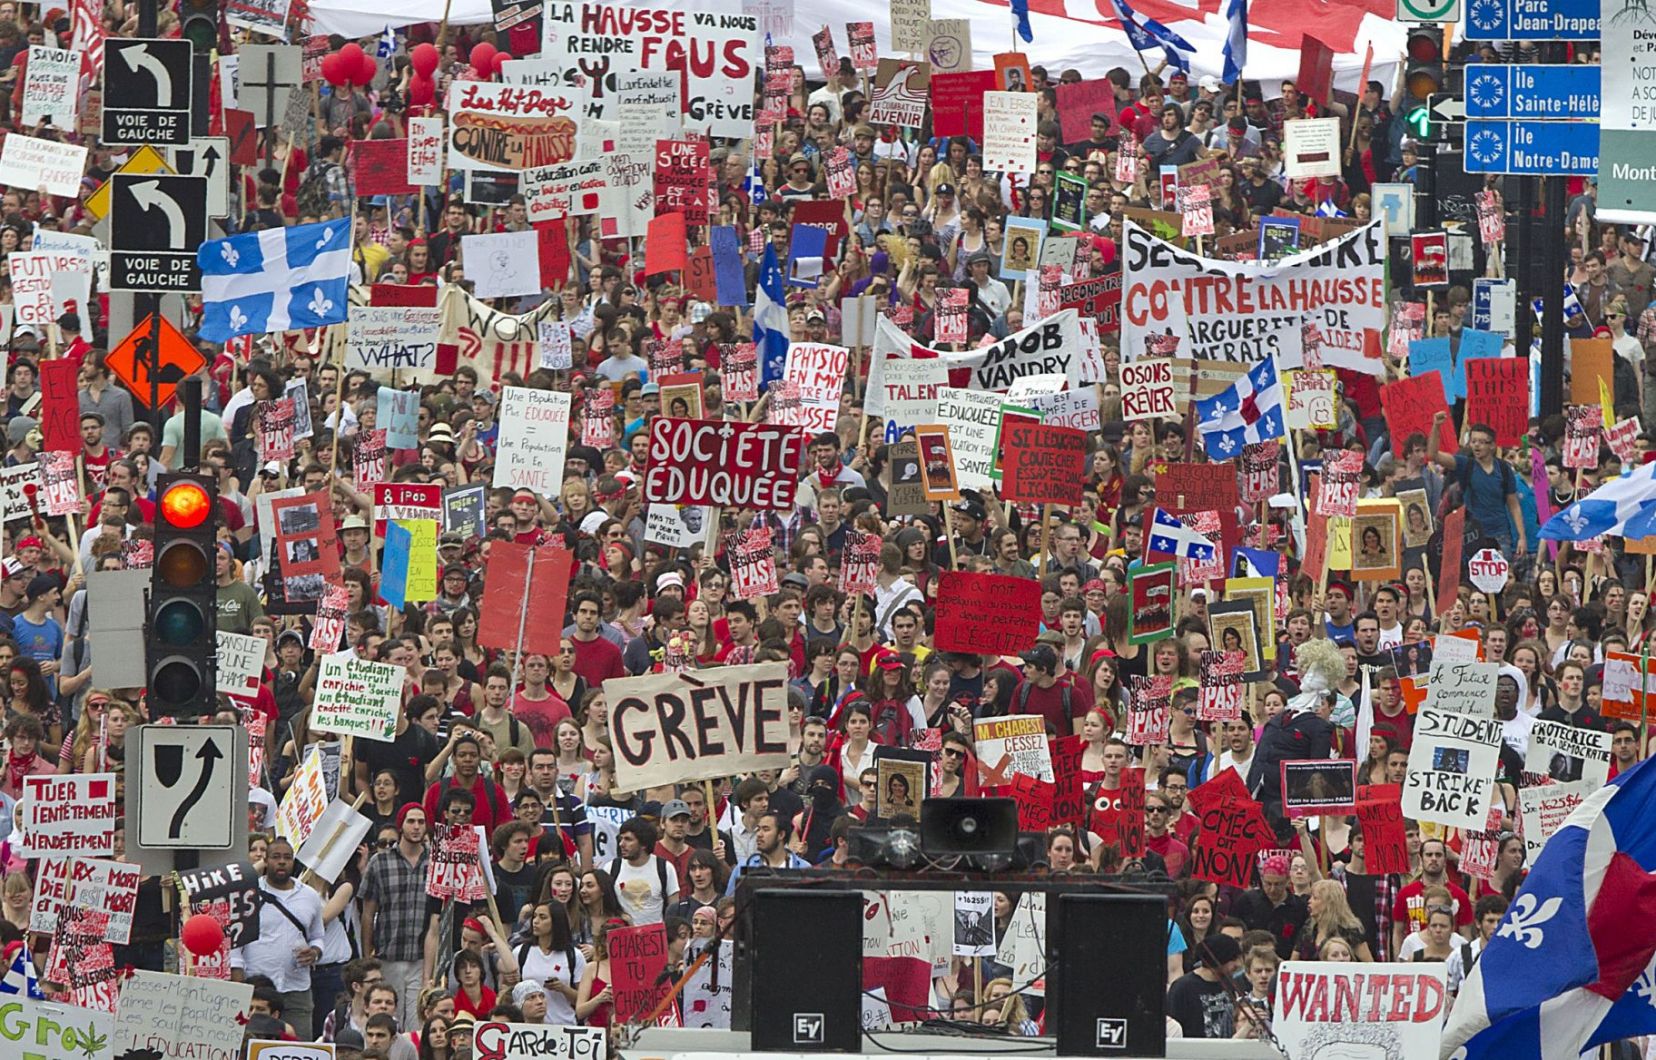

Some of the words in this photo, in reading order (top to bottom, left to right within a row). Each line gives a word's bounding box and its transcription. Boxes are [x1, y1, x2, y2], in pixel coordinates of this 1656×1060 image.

[1515, 0, 1548, 13] Parc
[551, 4, 574, 23] LA
[581, 4, 686, 36] HAUSSE
[694, 13, 716, 26] VA
[720, 15, 756, 31] NOUS
[926, 21, 961, 36] NON!
[567, 35, 634, 53] RENDRE
[33, 50, 78, 64] SAVOIR
[1515, 67, 1534, 89] Île
[460, 85, 495, 109] Les
[688, 96, 752, 121] GRÈVE
[881, 102, 911, 110] COMBAT
[912, 105, 923, 113] EST
[1632, 106, 1646, 120] DE
[116, 115, 148, 126] VOIE
[158, 115, 177, 126] DE
[871, 110, 922, 126] AVENIR
[117, 127, 175, 140] GAUCHE
[411, 136, 441, 149] Super
[1514, 123, 1533, 144] Île
[452, 127, 513, 165] CONTRE
[511, 141, 522, 154] LA
[522, 134, 575, 168] HAUSSE
[671, 143, 697, 156] UNE
[1514, 150, 1599, 169] Notre-Dame
[1185, 209, 1208, 225] PAS
[124, 258, 160, 270] VOIE
[170, 259, 191, 271] DE
[126, 273, 189, 286] GAUCHE
[1257, 285, 1286, 311] LA
[1288, 276, 1384, 311] HAUSSE
[940, 316, 967, 335] PAS
[1475, 314, 1491, 323] 715
[980, 323, 1063, 367] MOB
[358, 343, 435, 367] WHAT?
[791, 347, 847, 374] PHYSIO
[977, 354, 1072, 390] VANDRY
[1122, 362, 1172, 386] OSONS
[1467, 360, 1523, 379] FUCK
[725, 371, 751, 391] PAS
[789, 370, 807, 385] EN
[814, 373, 844, 389] MVT
[1472, 380, 1517, 394] THIS
[506, 389, 523, 401] Une
[528, 390, 569, 405] Population
[826, 388, 840, 400] LA
[941, 390, 959, 399] UNE
[1053, 392, 1071, 402] EST
[1122, 386, 1174, 417] RÊVER
[505, 404, 520, 417] Plus
[524, 404, 565, 423] ÉDUQUÉE
[937, 402, 1000, 426] ÉDUQUÉE
[1074, 400, 1088, 410] DE
[586, 417, 611, 439] PAS
[948, 424, 963, 434] EST
[965, 428, 985, 438] UNE
[265, 430, 290, 449] PAS
[500, 437, 518, 449] Une
[520, 437, 562, 453] Population
[651, 418, 801, 475] SOCIÉTÉ
[1570, 436, 1595, 459] PAS
[511, 453, 526, 464] Plus
[532, 455, 543, 467] En
[359, 463, 384, 483] PAS
[510, 467, 549, 488] SANTÉ
[1249, 468, 1277, 491] PAS
[50, 481, 77, 500] PAS
[645, 461, 792, 508] ÉDUQUÉE
[1203, 481, 1223, 491] LA
[1325, 482, 1352, 503] PAS
[384, 490, 393, 503] 8
[844, 531, 865, 546] NOUS
[738, 561, 769, 587] PAS
[846, 562, 875, 584] PAS
[1471, 561, 1509, 577] STOP
[244, 640, 259, 654] LE
[346, 659, 395, 677] étudiant
[1200, 652, 1225, 665] NOUS
[349, 672, 390, 684] instruit
[1130, 675, 1152, 689] NOUS
[1201, 672, 1245, 687] RECULERONS
[1431, 664, 1444, 684] Le
[322, 680, 365, 693] enrichie
[370, 685, 400, 697] société
[1204, 686, 1236, 710] PAS
[1436, 688, 1488, 699] commence
[320, 694, 332, 702] un
[335, 692, 385, 707] étudiant
[355, 705, 392, 718] enrichie
[613, 673, 787, 766] GRÈVE
[1135, 708, 1163, 733] PAS
[317, 716, 331, 727] les
[977, 724, 994, 739] M.
[996, 718, 1043, 737] CHAREST
[1420, 711, 1504, 742] STUDENTS
[1004, 735, 1044, 753] CESSEZ
[1537, 736, 1545, 744] DE
[1547, 738, 1557, 748] LA
[1017, 751, 1040, 761] HAUSSE
[1020, 761, 1040, 771] FRAIS
[27, 778, 78, 801] TUER
[1015, 781, 1041, 798] LE
[1220, 796, 1236, 810] LE
[1420, 791, 1480, 817] BACK
[433, 824, 456, 841] NOUS
[1204, 809, 1256, 838] CMÉC
[23, 827, 31, 847] À
[1217, 837, 1237, 848] DIT
[432, 850, 478, 865] RECULERONS
[1375, 844, 1401, 870] NON
[42, 858, 96, 882] MARX
[108, 869, 140, 887] MORT
[433, 864, 467, 886] PAS
[1194, 853, 1249, 885] NON
[181, 864, 242, 895] HIKE
[40, 878, 76, 900] DIEU
[103, 891, 136, 913] MORT
[37, 900, 49, 913] ET
[58, 905, 85, 922] NOUS
[55, 932, 104, 947] RECULERONS
[609, 929, 666, 958] CHAREST
[626, 962, 646, 980] TU
[77, 982, 111, 1011] PAS
[126, 975, 240, 1012] Passe-Montagne
[1280, 972, 1445, 1023] WANTED
[118, 998, 150, 1012] aime
[158, 1001, 177, 1014] les
[180, 1005, 236, 1030] papillons
[115, 1027, 130, 1040] et
[117, 1012, 143, 1025] Les
[152, 1016, 203, 1036] souliers
[207, 1028, 242, 1044] neufs
[798, 1019, 820, 1039] EV
[1101, 1023, 1123, 1043] EV
[559, 1037, 568, 1052] à
